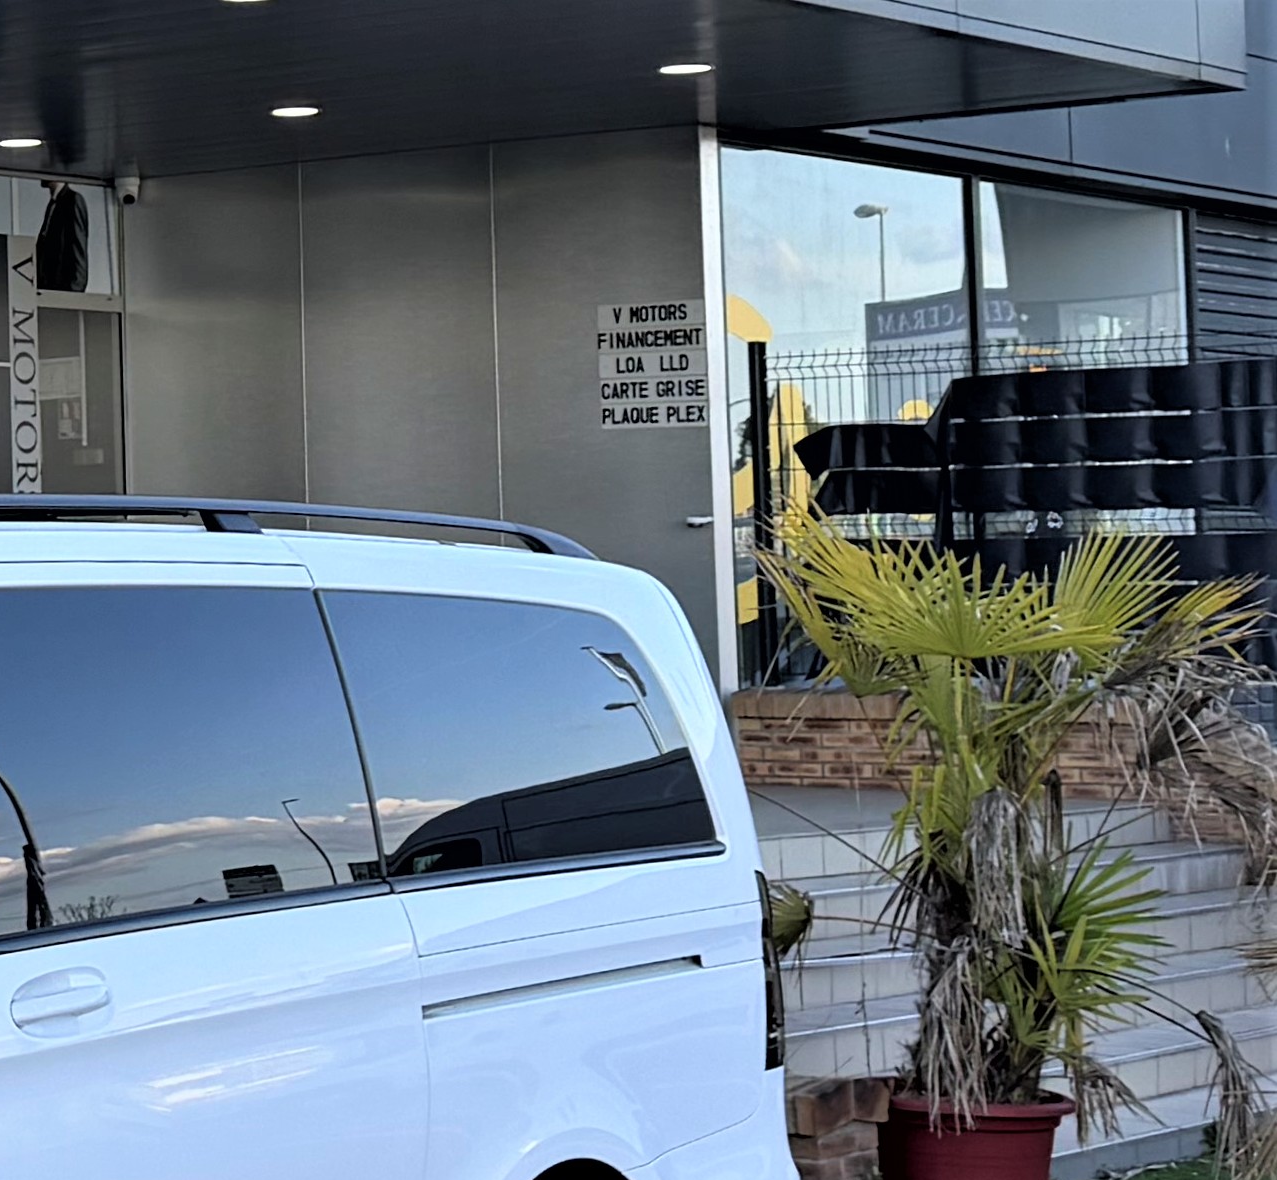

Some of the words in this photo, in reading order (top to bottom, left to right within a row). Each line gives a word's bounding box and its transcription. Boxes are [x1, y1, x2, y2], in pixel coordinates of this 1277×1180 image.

[12, 253, 34, 287] V
[613, 306, 622, 324] V
[629, 303, 688, 323] MOTORS
[597, 328, 703, 350] FINANCEMENT
[615, 356, 645, 374] LOA
[660, 354, 689, 372] LLD
[601, 381, 649, 400] CARTE
[656, 379, 705, 398] GRISE
[12, 308, 41, 493] MOTOR
[602, 406, 659, 425] PLAQUE
[666, 405, 706, 424] PLEX
